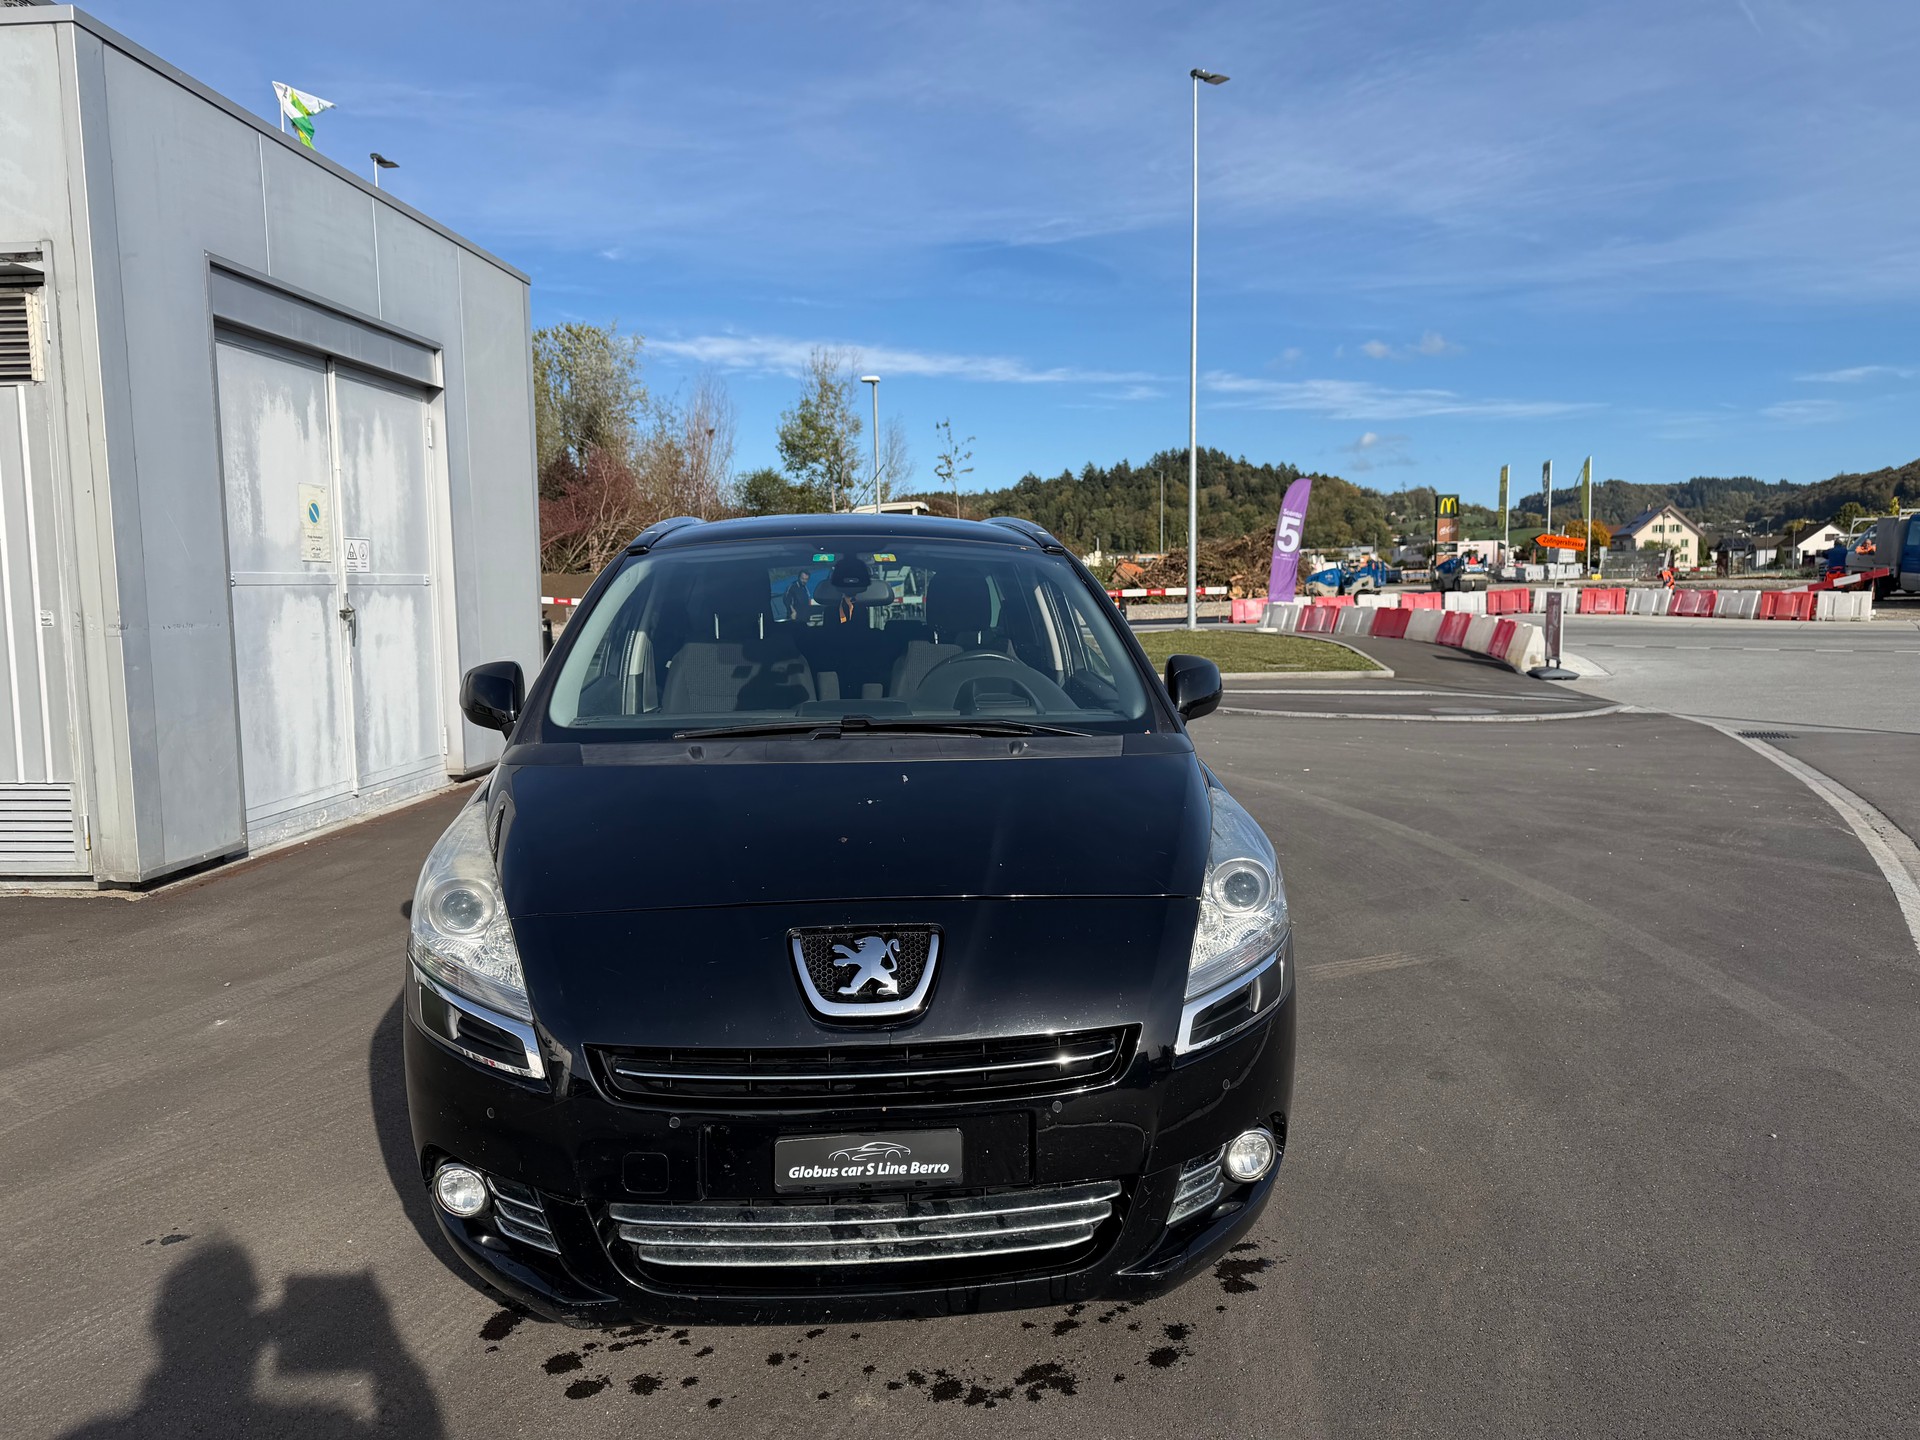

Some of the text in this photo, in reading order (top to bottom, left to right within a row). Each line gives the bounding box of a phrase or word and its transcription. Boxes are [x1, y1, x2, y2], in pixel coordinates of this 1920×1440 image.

[1276, 516, 1300, 552] 5
[1543, 537, 1584, 548] Zofingerstrasse
[788, 1161, 949, 1178] Globus car S Line Berro
